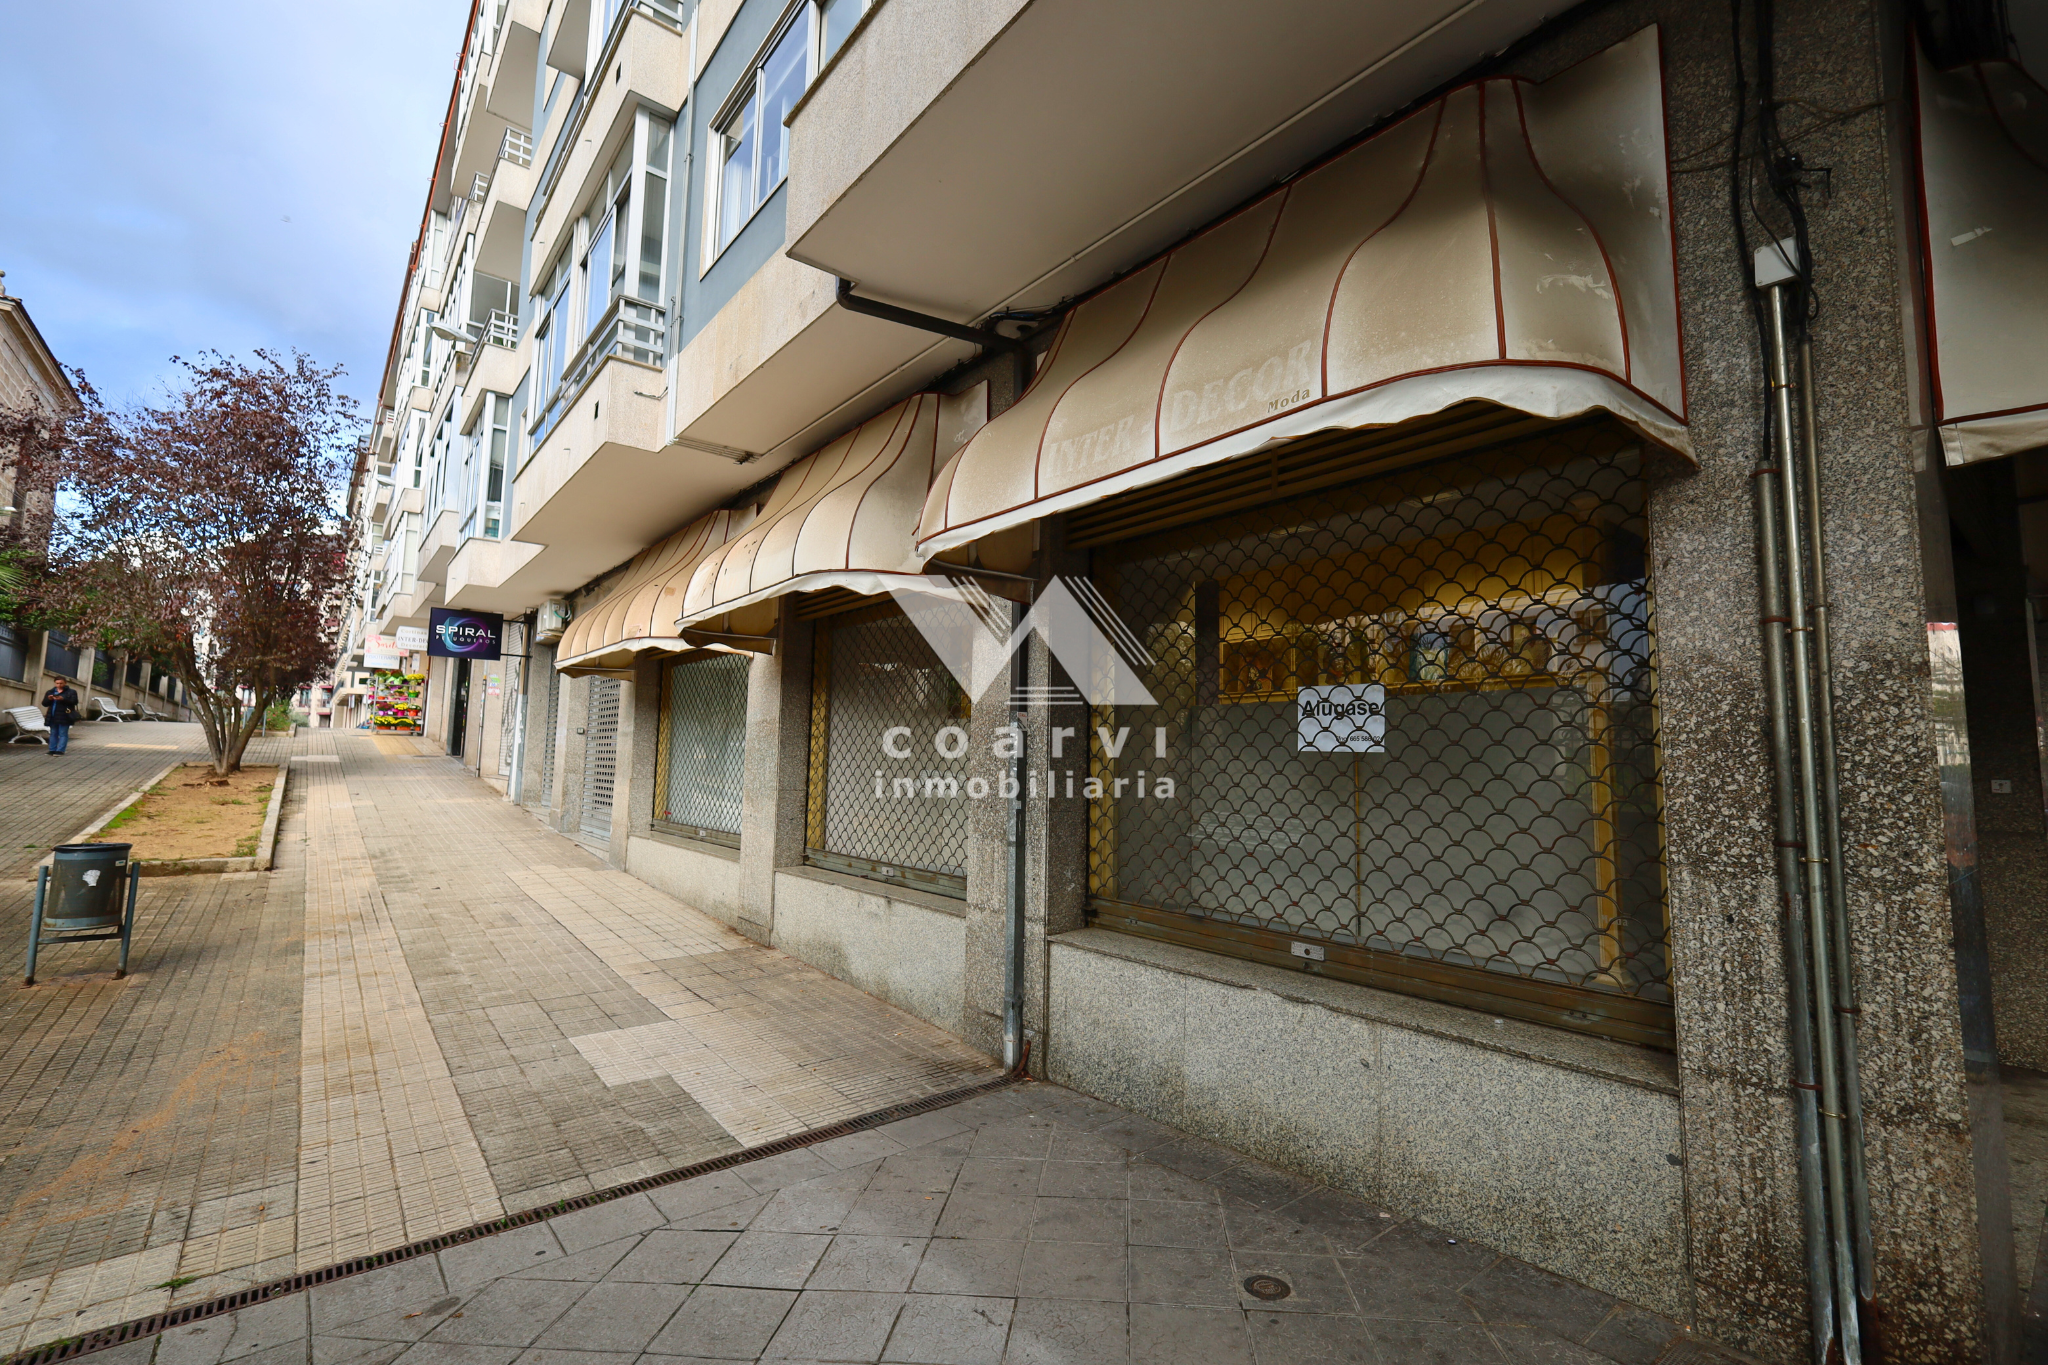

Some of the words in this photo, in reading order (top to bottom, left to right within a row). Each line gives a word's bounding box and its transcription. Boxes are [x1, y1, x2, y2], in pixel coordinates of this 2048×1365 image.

[1168, 339, 1312, 432] DECOR
[1267, 388, 1311, 413] Moda
[398, 636, 428, 644] INTER-DE
[435, 624, 496, 639] SPIRAL
[435, 634, 496, 645] PEUQUEROS
[1301, 700, 1380, 721] Alugase
